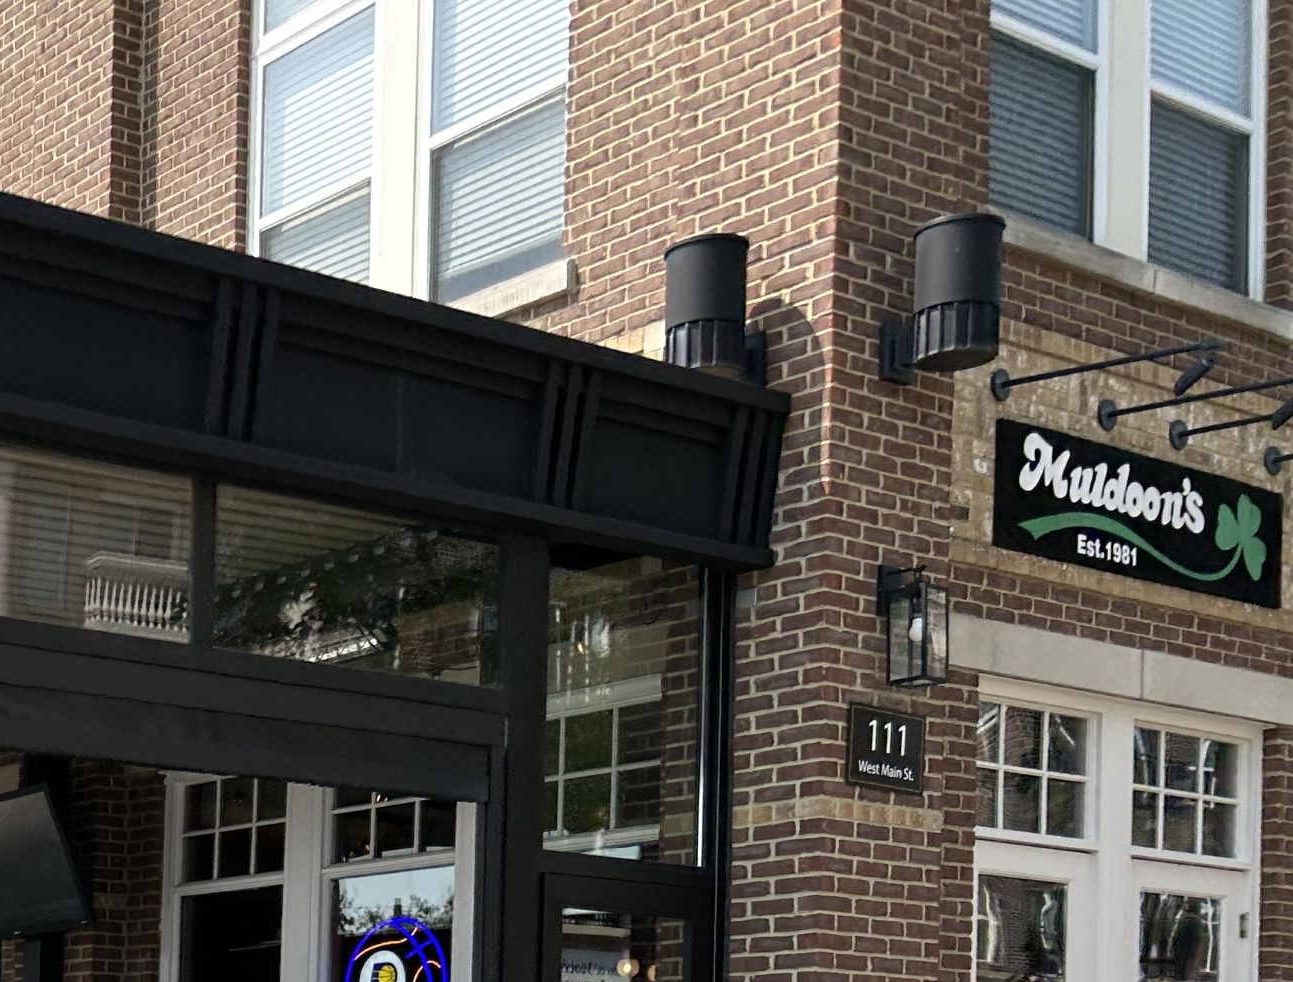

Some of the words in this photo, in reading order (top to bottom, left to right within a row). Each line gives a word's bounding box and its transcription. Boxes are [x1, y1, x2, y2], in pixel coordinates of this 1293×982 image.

[1018, 432, 1206, 534] Muldoon's
[868, 719, 906, 757] 111
[858, 759, 880, 775] West
[881, 763, 903, 779] Main
[903, 767, 914, 781] St.
